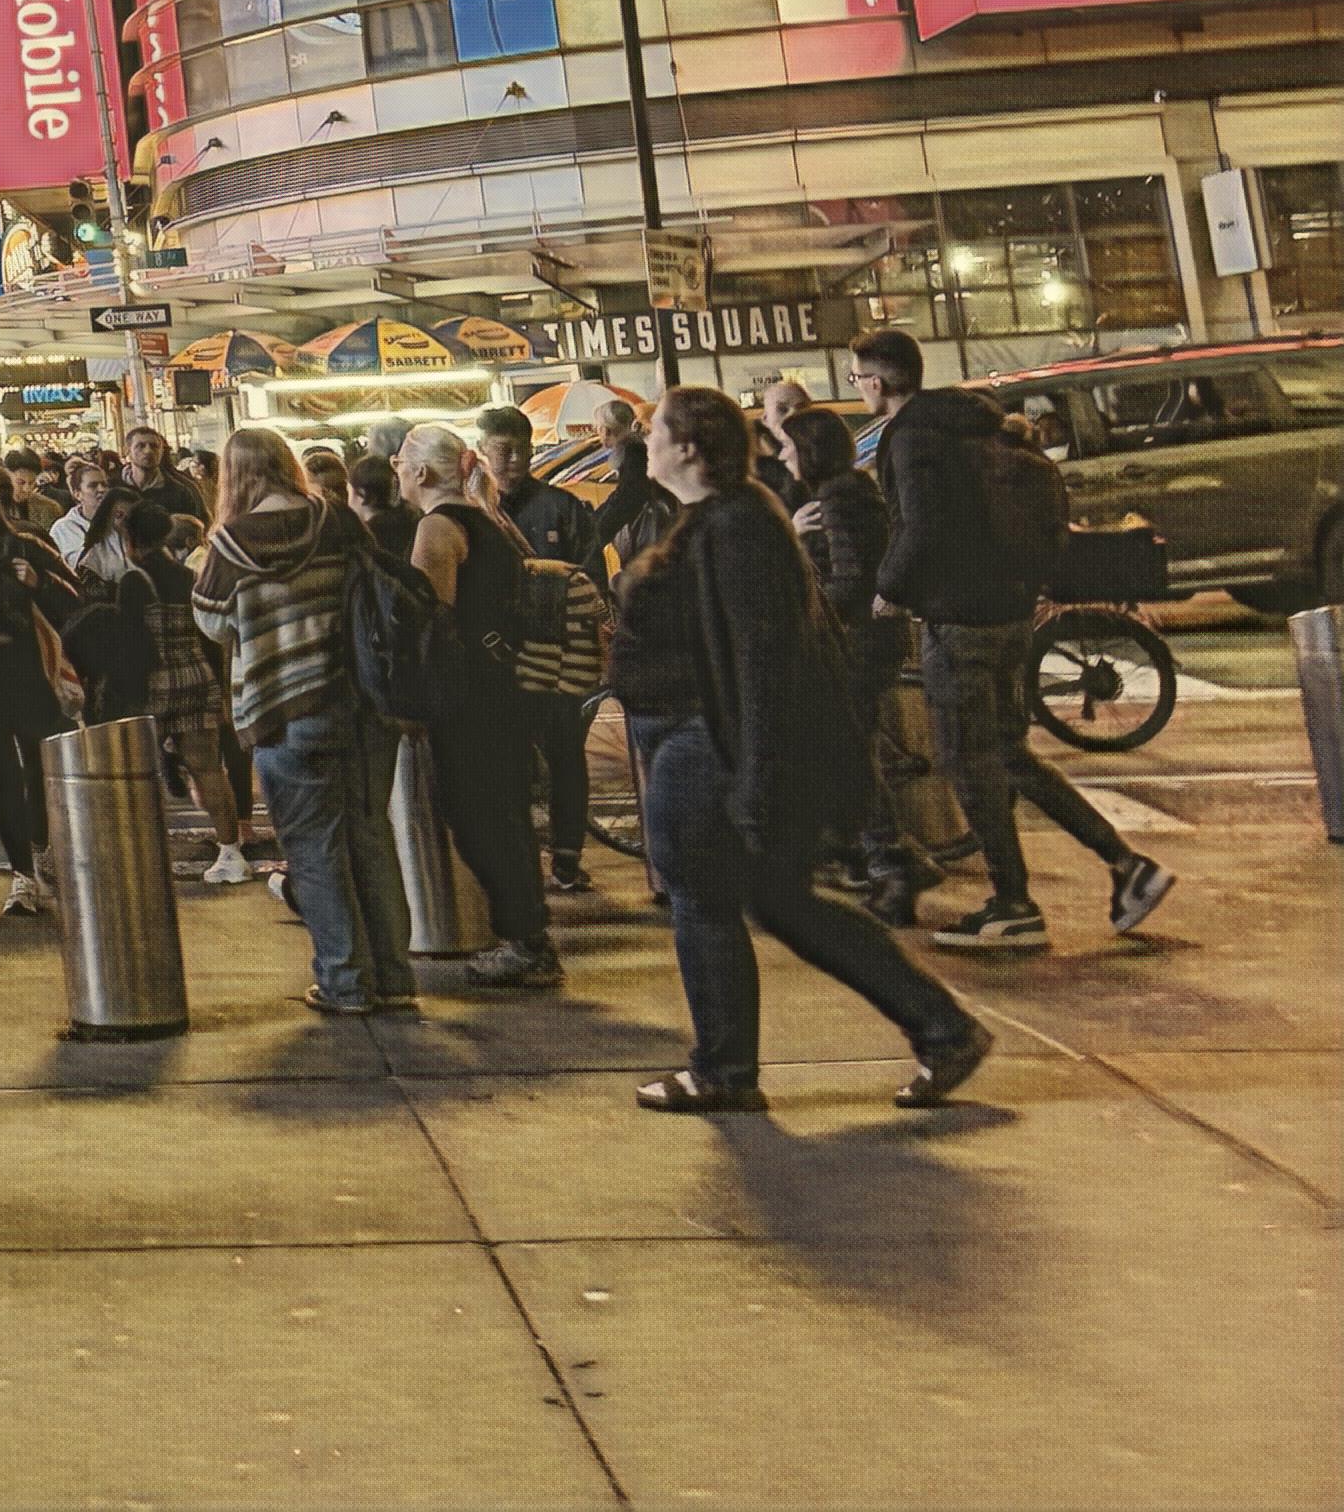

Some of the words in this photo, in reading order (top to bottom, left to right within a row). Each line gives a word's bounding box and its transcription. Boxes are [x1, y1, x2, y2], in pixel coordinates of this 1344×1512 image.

[135, 309, 162, 324] WAY
[542, 314, 656, 361] TIMES
[671, 302, 818, 352] SQUARE
[21, 384, 85, 405] IMAX
